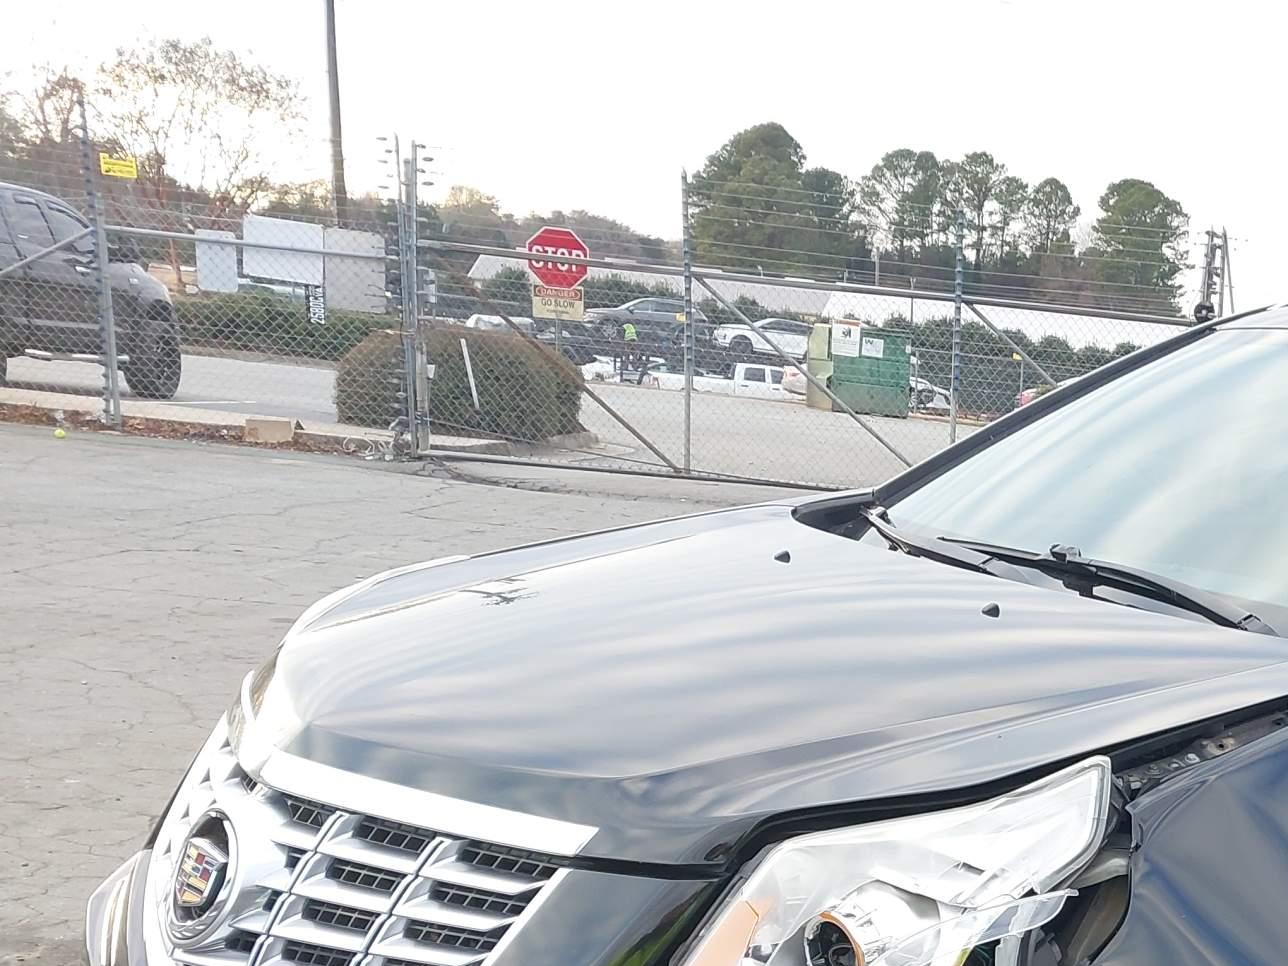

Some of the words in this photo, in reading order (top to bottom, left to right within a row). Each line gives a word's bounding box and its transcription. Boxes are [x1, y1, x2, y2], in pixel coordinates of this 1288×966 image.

[531, 245, 584, 272] STOP
[541, 289, 576, 298] DANGER
[554, 300, 576, 309] SLOW
